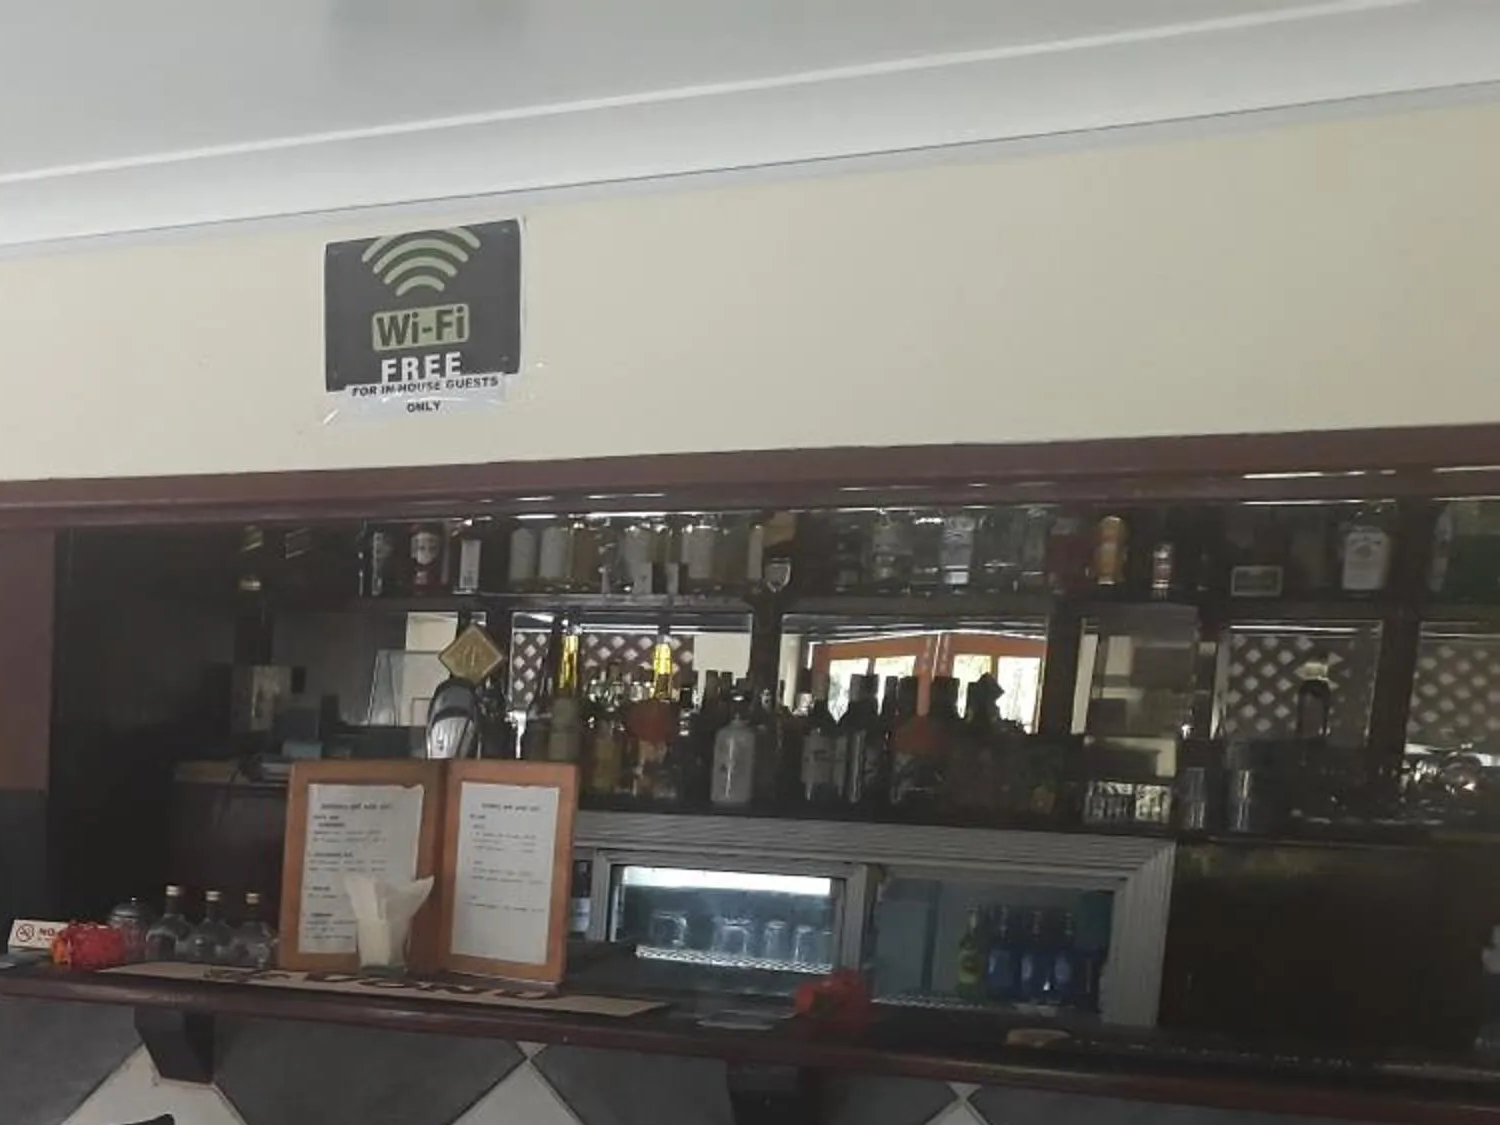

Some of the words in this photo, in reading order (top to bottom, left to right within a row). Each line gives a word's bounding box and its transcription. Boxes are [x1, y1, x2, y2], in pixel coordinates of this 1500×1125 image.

[376, 306, 465, 347] Wi-Fi
[381, 351, 462, 384] FREE
[352, 385, 377, 397] FOR
[445, 375, 499, 390] GUESTS
[407, 400, 441, 413] ONLY
